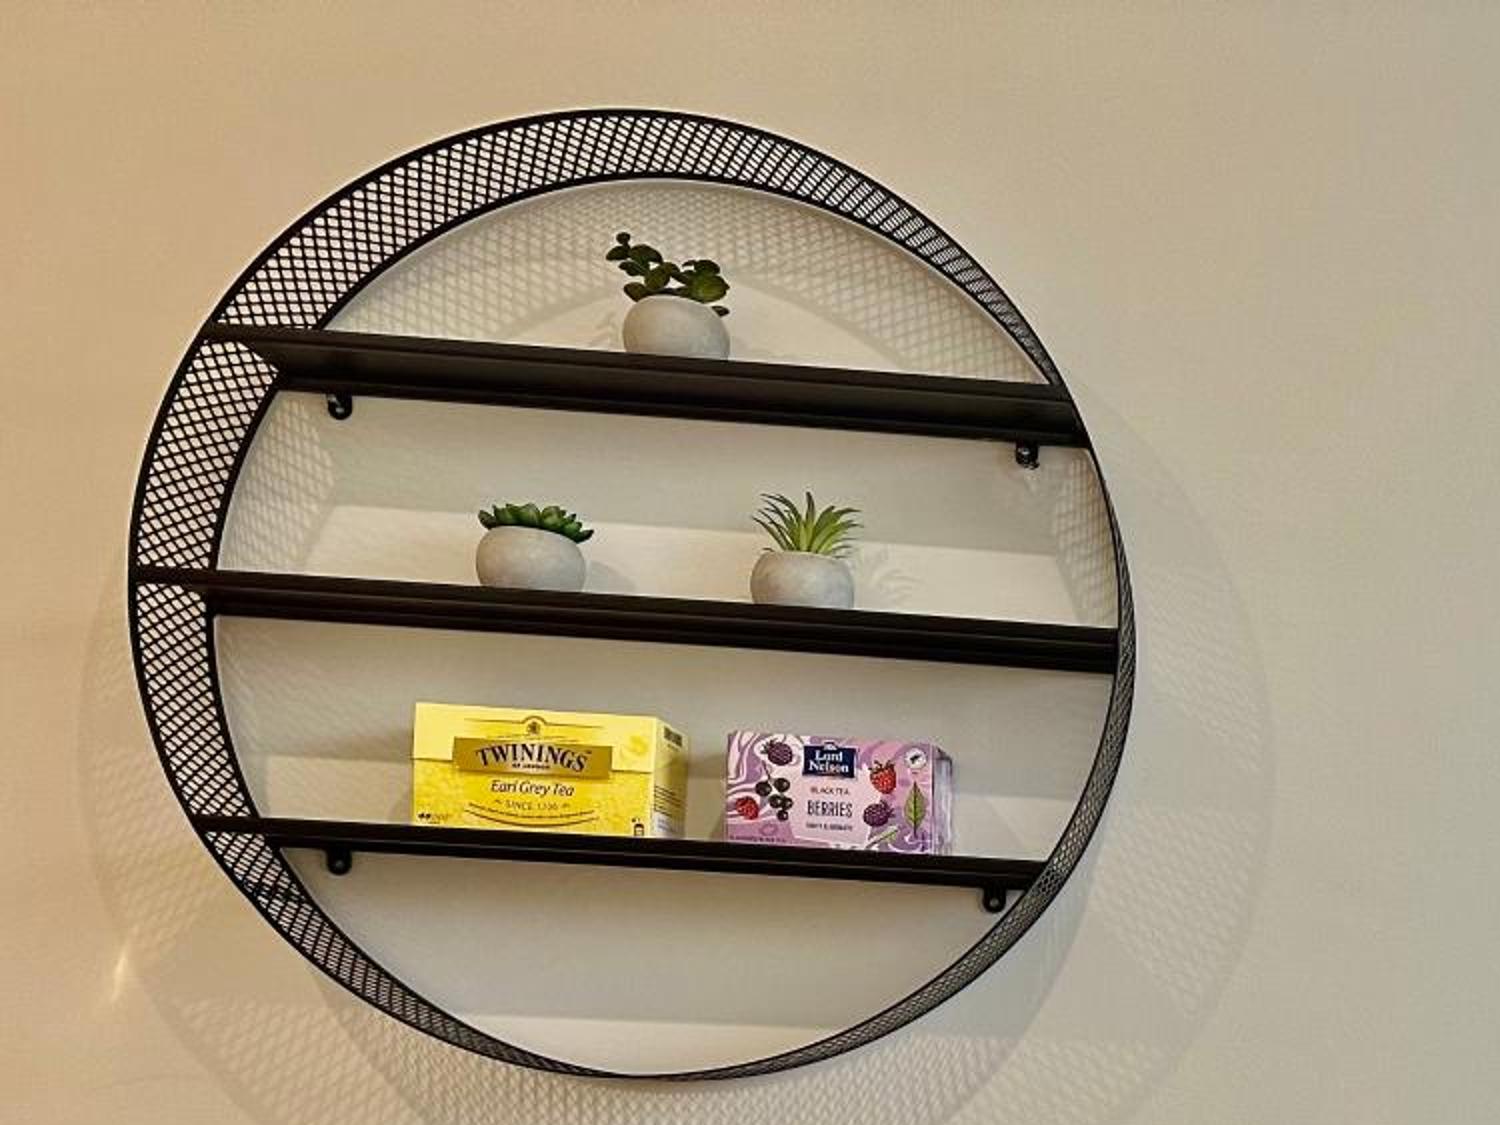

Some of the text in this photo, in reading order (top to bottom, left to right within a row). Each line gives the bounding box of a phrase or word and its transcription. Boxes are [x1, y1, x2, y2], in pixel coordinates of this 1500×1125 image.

[475, 743, 588, 772] TWININGS
[815, 750, 843, 762] Lord
[809, 760, 849, 773] Nelson
[491, 779, 575, 798] Earl Grey Tea
[807, 799, 853, 818] BERRIES
